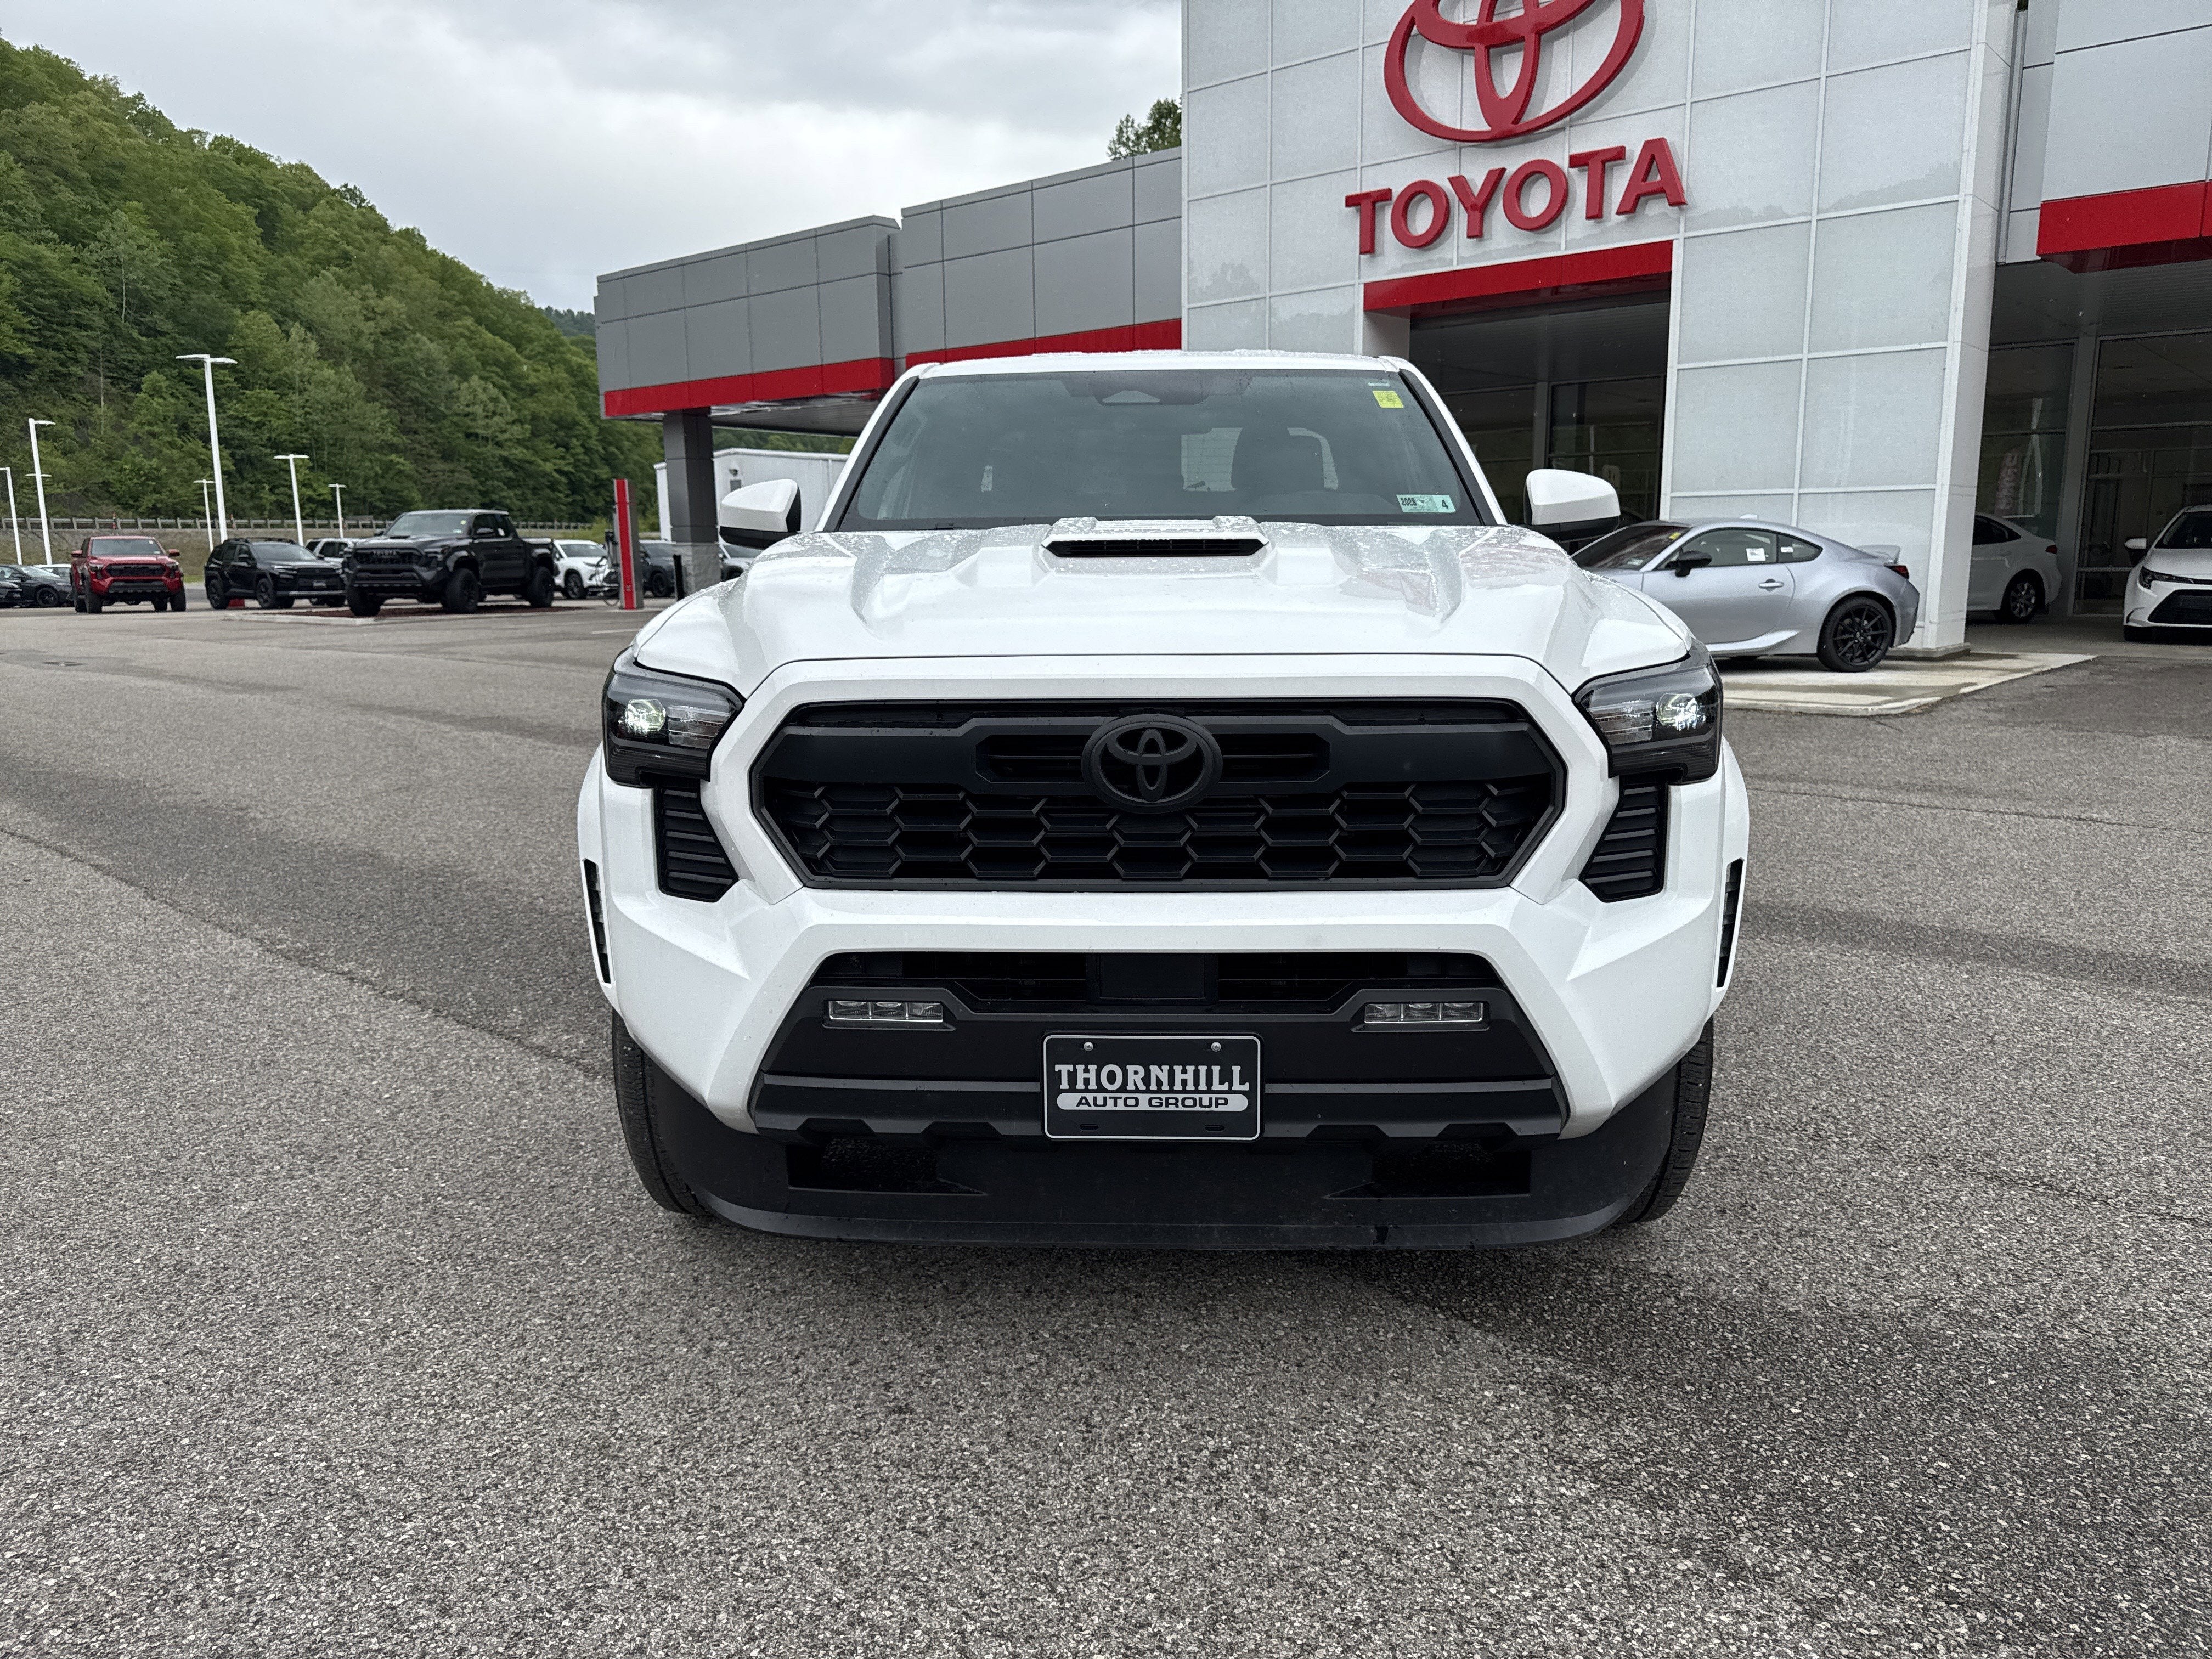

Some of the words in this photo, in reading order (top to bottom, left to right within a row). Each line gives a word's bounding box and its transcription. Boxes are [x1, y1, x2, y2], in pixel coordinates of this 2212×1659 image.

[1345, 137, 1688, 255] TOYOTA
[1400, 497, 1416, 506] 2028
[1442, 500, 1449, 509] 4
[1054, 1064, 1250, 1091] THORNHILL
[1076, 1096, 1139, 1108] AUTO
[1148, 1096, 1229, 1109] GROUP
